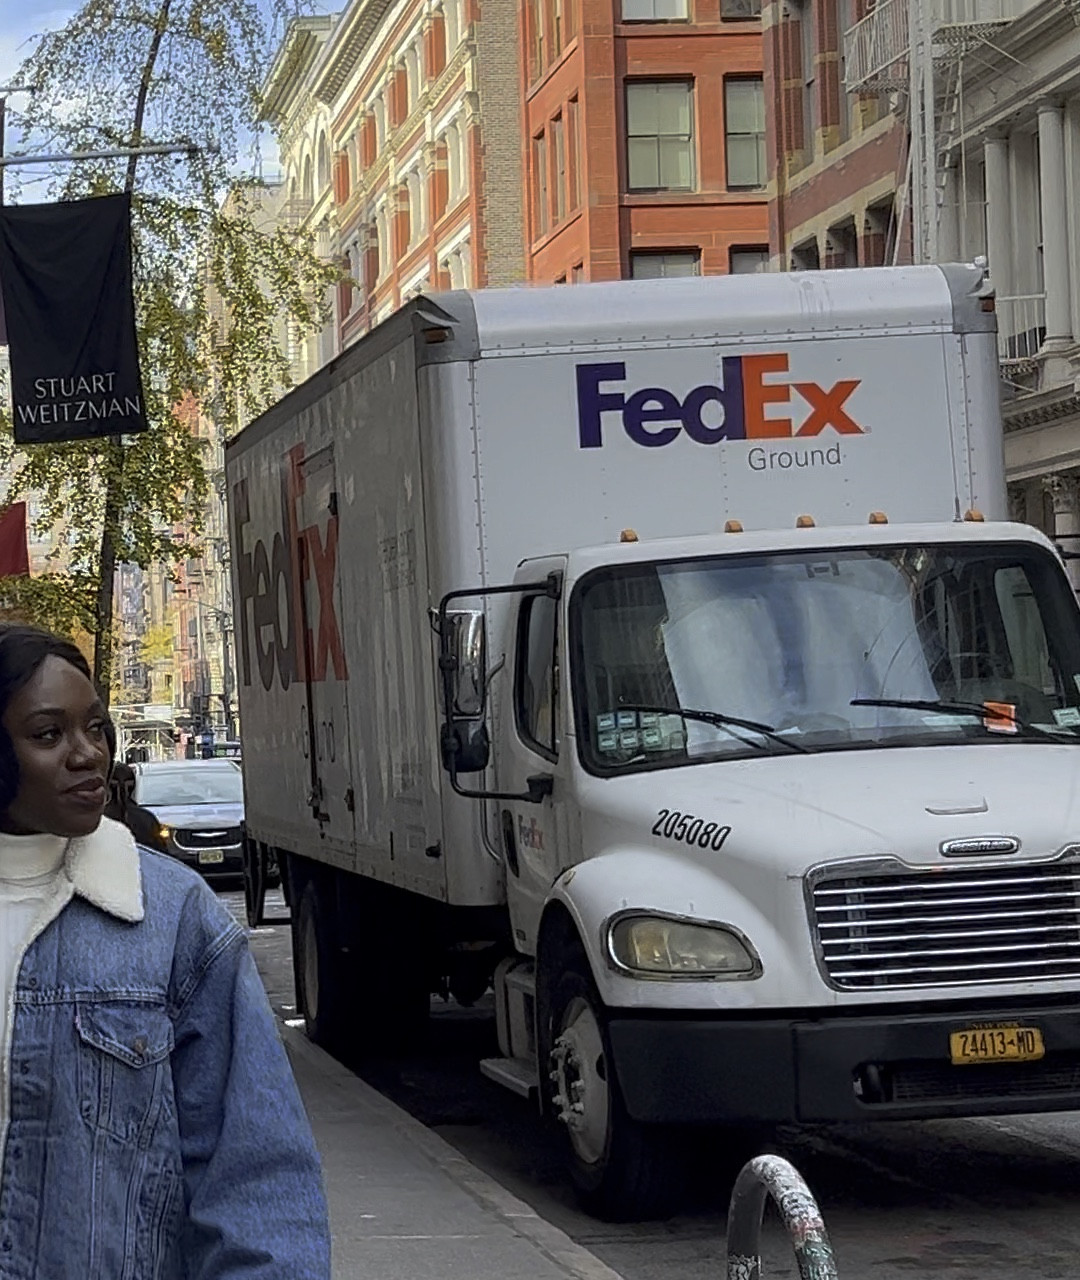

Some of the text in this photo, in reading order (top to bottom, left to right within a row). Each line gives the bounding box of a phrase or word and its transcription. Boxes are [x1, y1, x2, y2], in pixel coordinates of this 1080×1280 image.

[34, 372, 116, 399] STUART
[18, 395, 141, 424] WEITZMAN
[575, 353, 866, 449] FedEx
[748, 442, 842, 471] Ground
[651, 809, 732, 851] 205080
